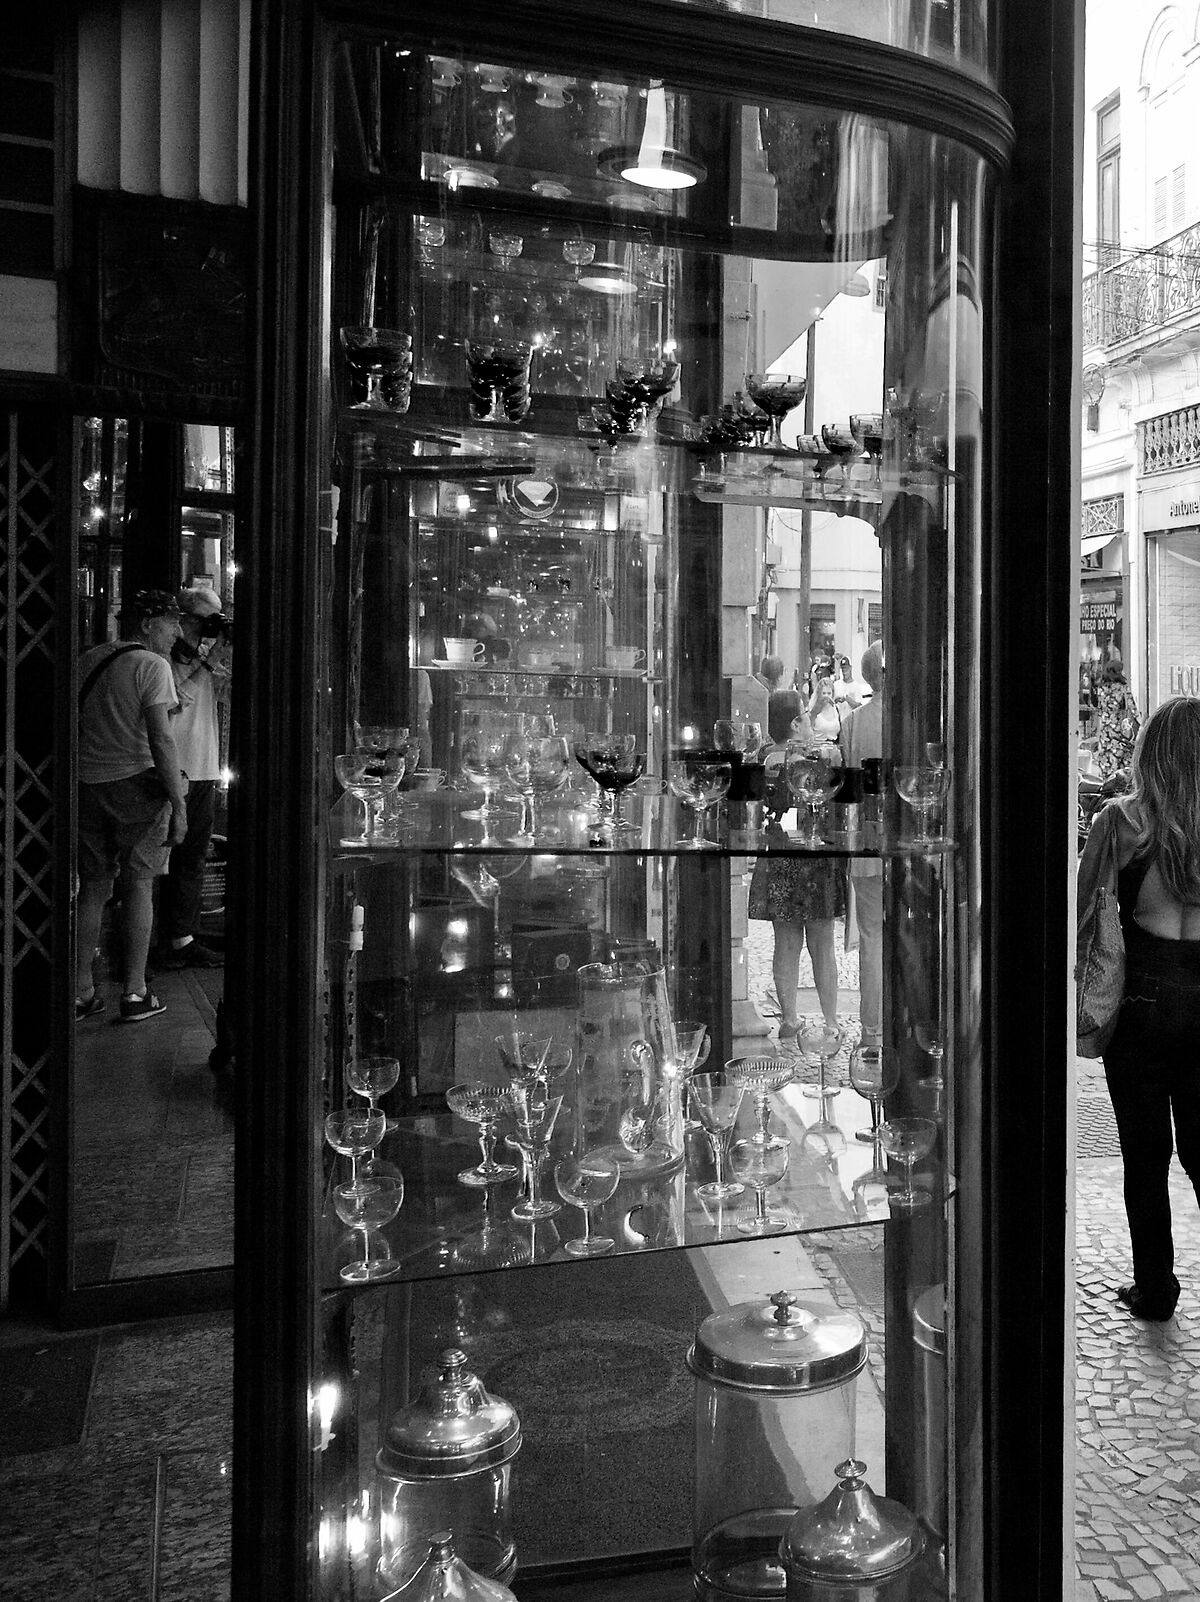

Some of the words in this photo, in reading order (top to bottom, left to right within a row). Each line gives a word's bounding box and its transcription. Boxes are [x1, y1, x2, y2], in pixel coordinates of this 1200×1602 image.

[1090, 603, 1117, 618] ESPECIAL
[1097, 619, 1105, 631] DO
[1106, 618, 1115, 630] RIO
